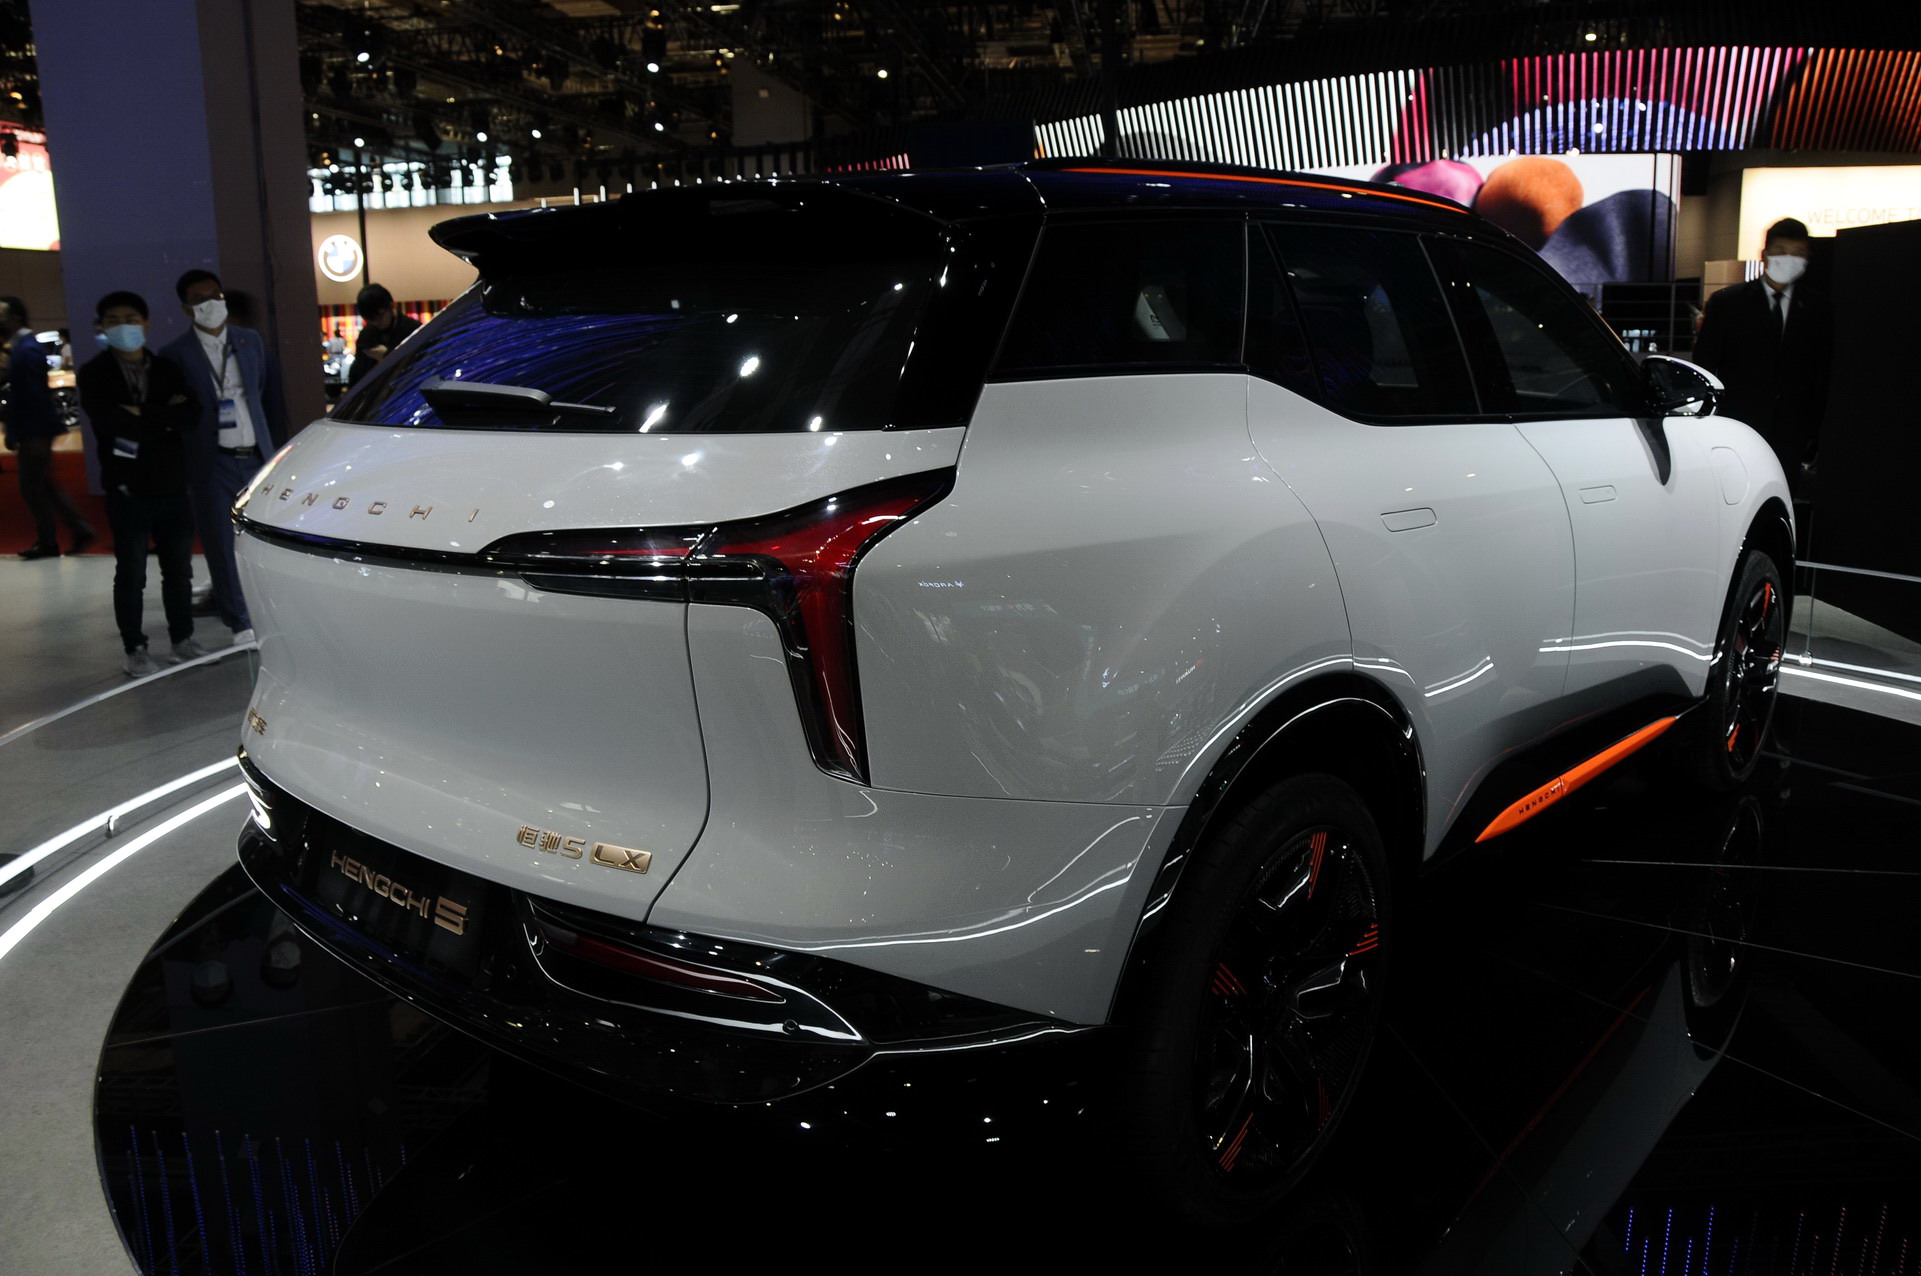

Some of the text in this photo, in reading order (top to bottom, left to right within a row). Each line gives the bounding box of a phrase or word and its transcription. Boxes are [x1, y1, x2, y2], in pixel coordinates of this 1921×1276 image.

[1808, 207, 1921, 224] WELCOME T
[260, 484, 480, 523] HENGCHI
[593, 843, 648, 871] LX
[331, 849, 431, 919] HENGCHI
